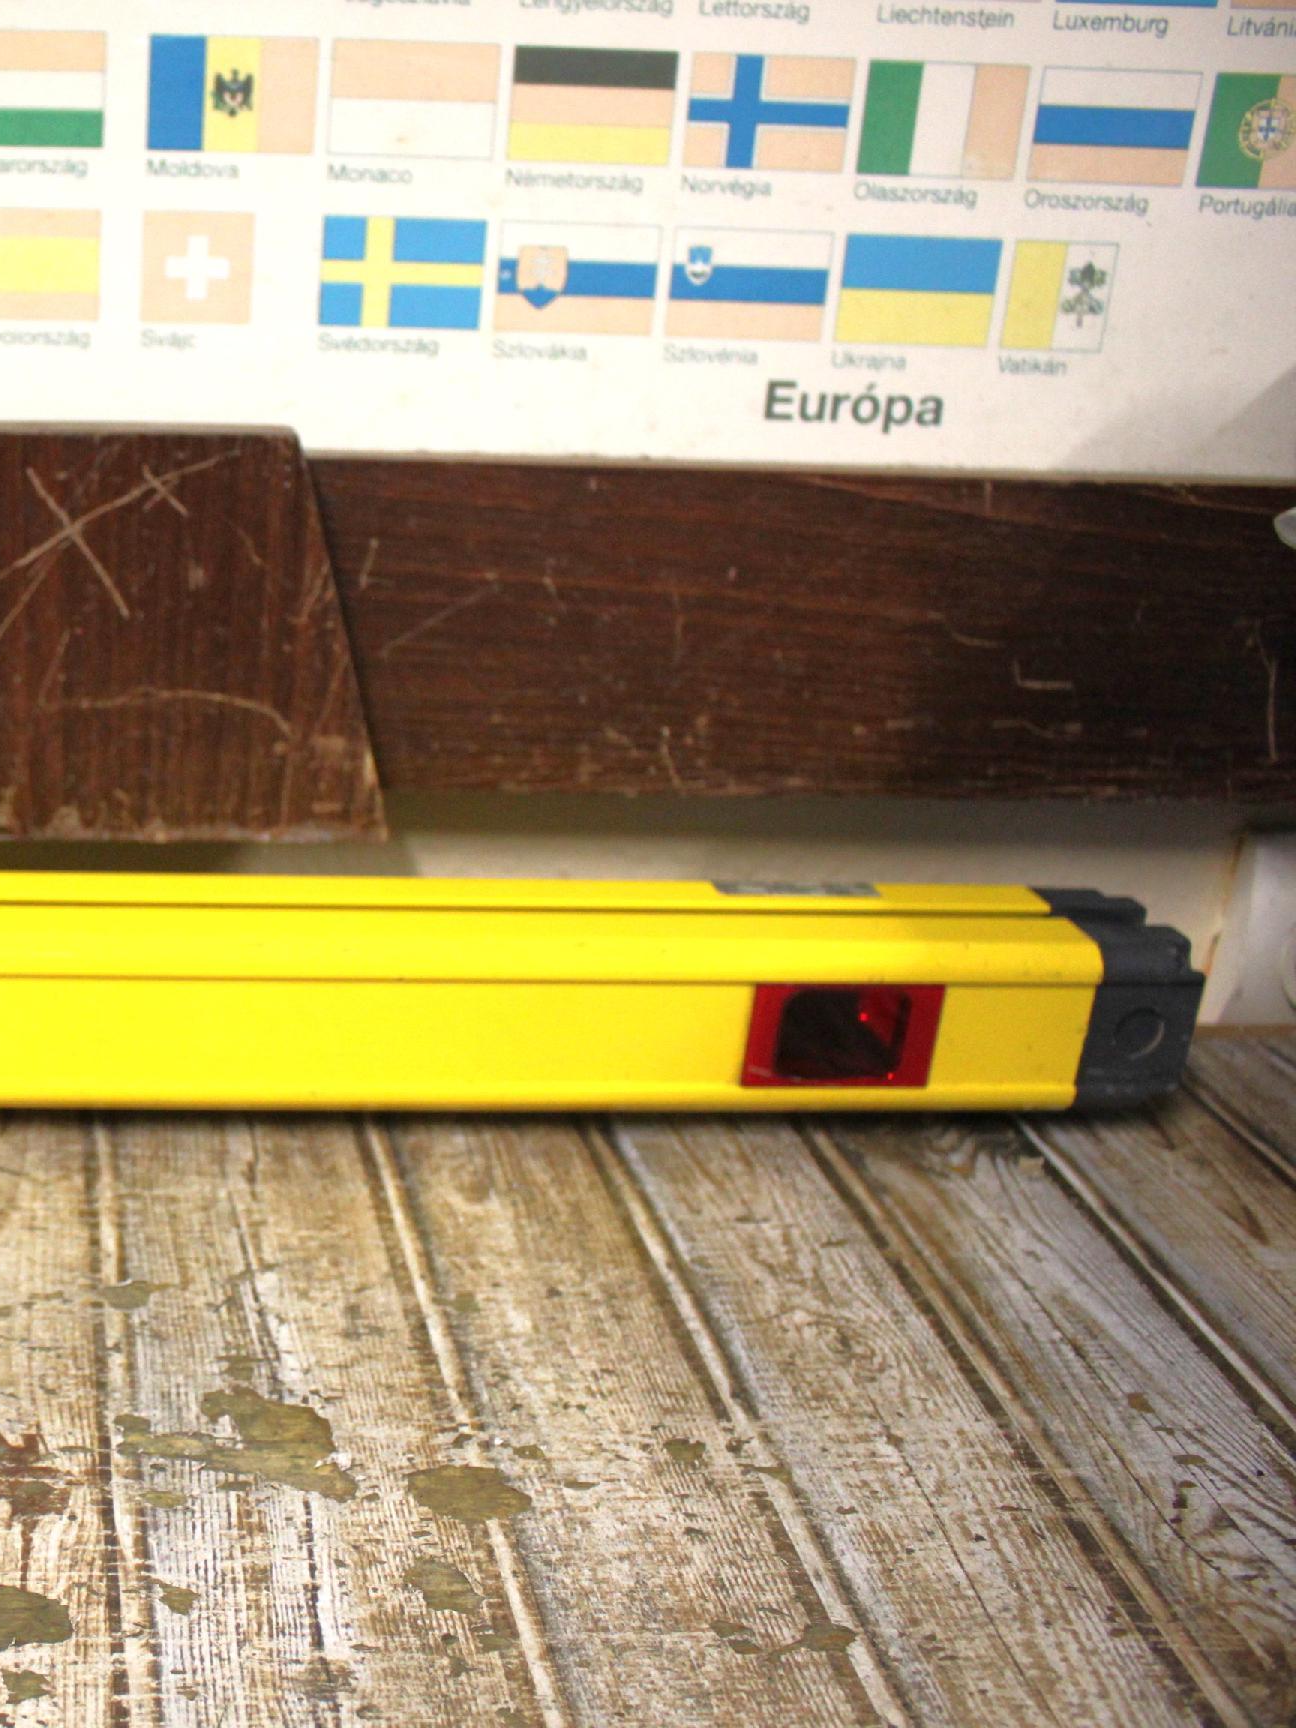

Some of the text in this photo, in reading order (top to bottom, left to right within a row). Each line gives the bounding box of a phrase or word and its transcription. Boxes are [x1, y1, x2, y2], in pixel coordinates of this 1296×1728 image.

[699, 0, 811, 24] Lettország
[877, 6, 1015, 29] Liechtenstein
[1053, 11, 1169, 37] Luxemburg
[1227, 15, 1296, 37] Litváni
[145, 158, 241, 180] Moldova
[326, 163, 414, 184] Monaco
[505, 168, 644, 194] Németország
[681, 174, 772, 199] Norvégia
[853, 181, 979, 209] Olaszország
[1024, 188, 1150, 215] Oroszország
[318, 331, 439, 357] Svédország
[492, 339, 588, 363] Szlovákia
[663, 343, 758, 366] Szlovénia
[831, 350, 907, 373] Ukrajna
[997, 354, 1068, 376] Vatikán
[764, 379, 944, 435] Európa
